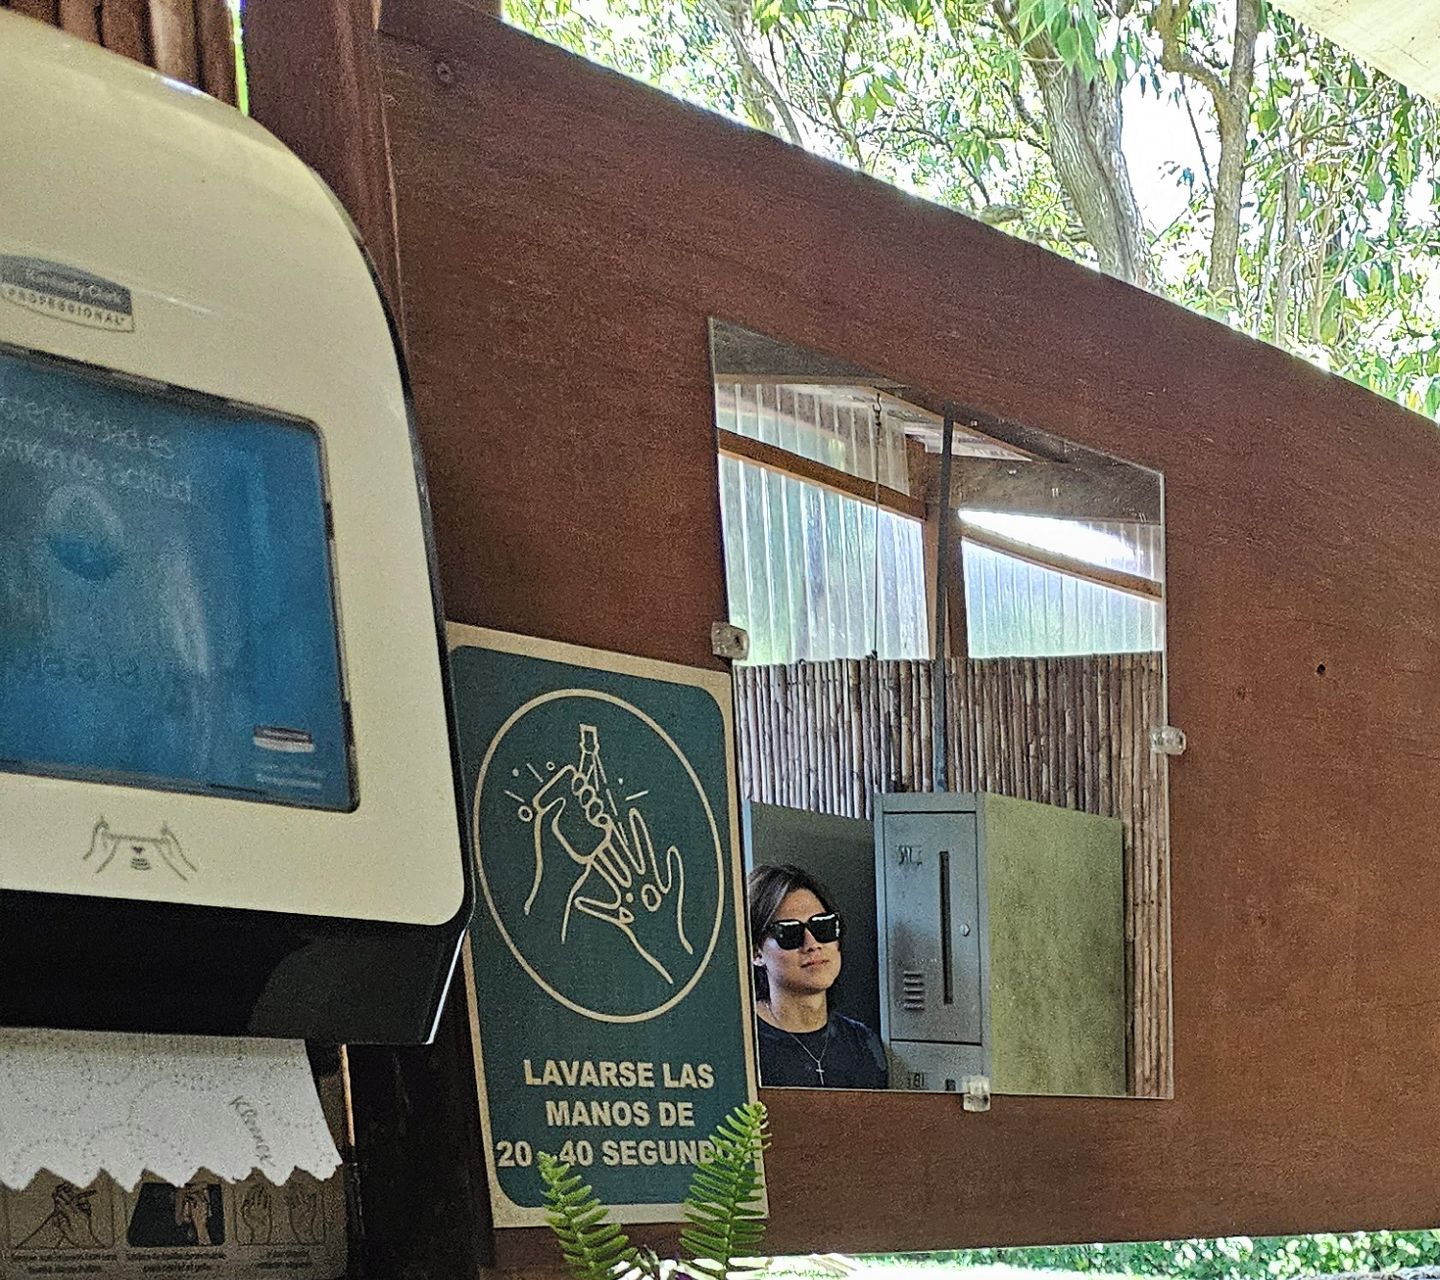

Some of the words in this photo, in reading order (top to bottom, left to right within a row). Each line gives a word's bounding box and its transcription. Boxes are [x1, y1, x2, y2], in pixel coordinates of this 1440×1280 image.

[523, 1059, 655, 1087] LAVARSE
[662, 1063, 714, 1089] LAS
[545, 1101, 650, 1127] MANOS
[659, 1102, 695, 1127] DE
[496, 1141, 532, 1167] 20
[558, 1140, 594, 1167] 40
